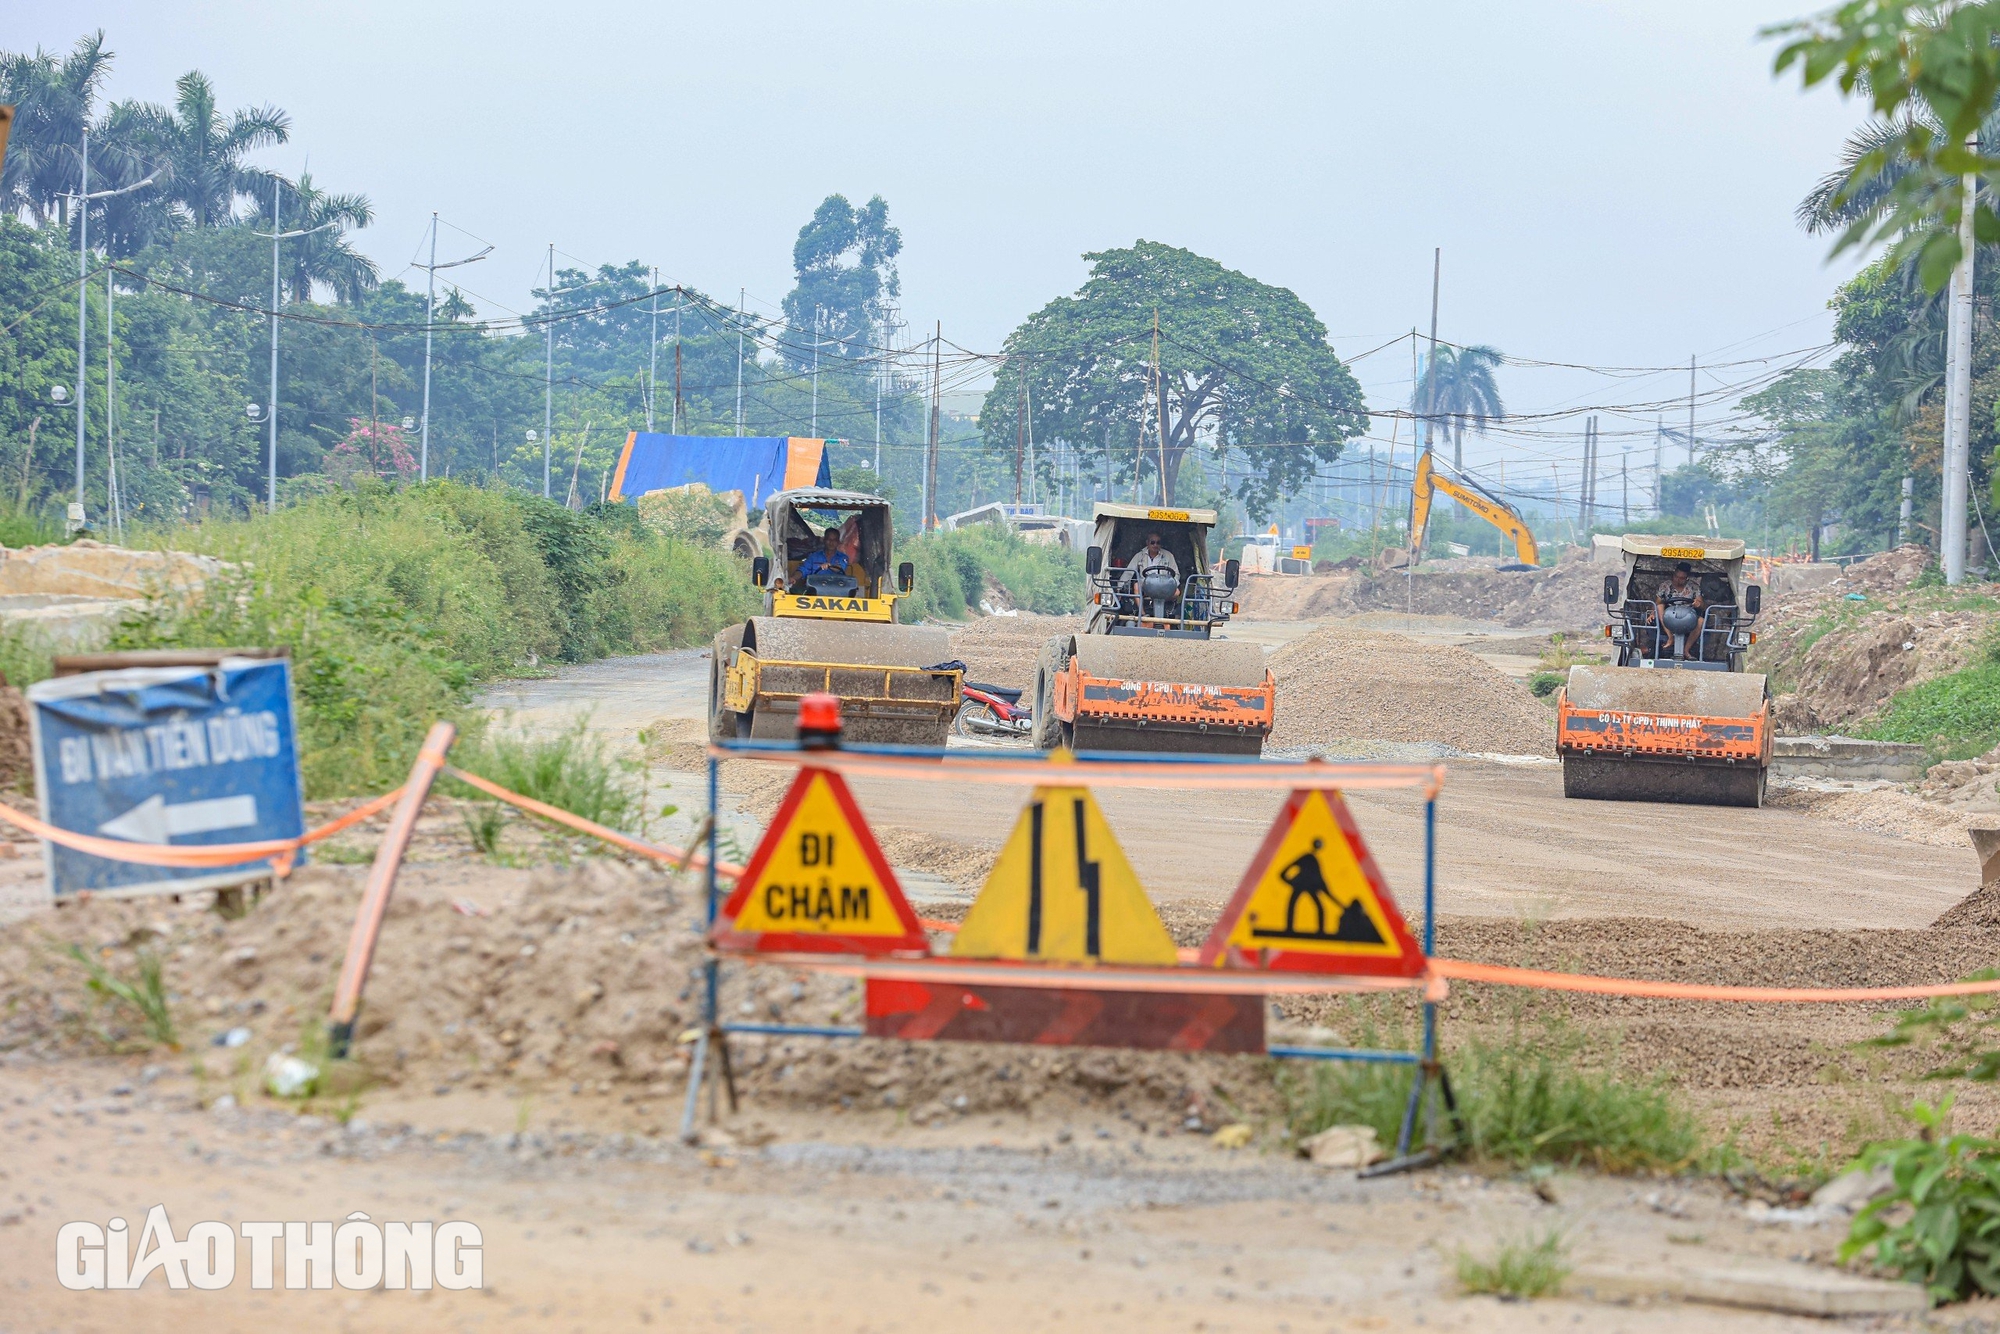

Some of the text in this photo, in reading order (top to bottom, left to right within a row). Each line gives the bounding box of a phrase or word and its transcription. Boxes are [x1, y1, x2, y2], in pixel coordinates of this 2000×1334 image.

[1452, 490, 1489, 513] SUMITOMO
[795, 596, 869, 612] SAKAI
[1622, 714, 1632, 724] TY
[800, 832, 835, 867] ĐI
[765, 877, 870, 930] CHẬM
